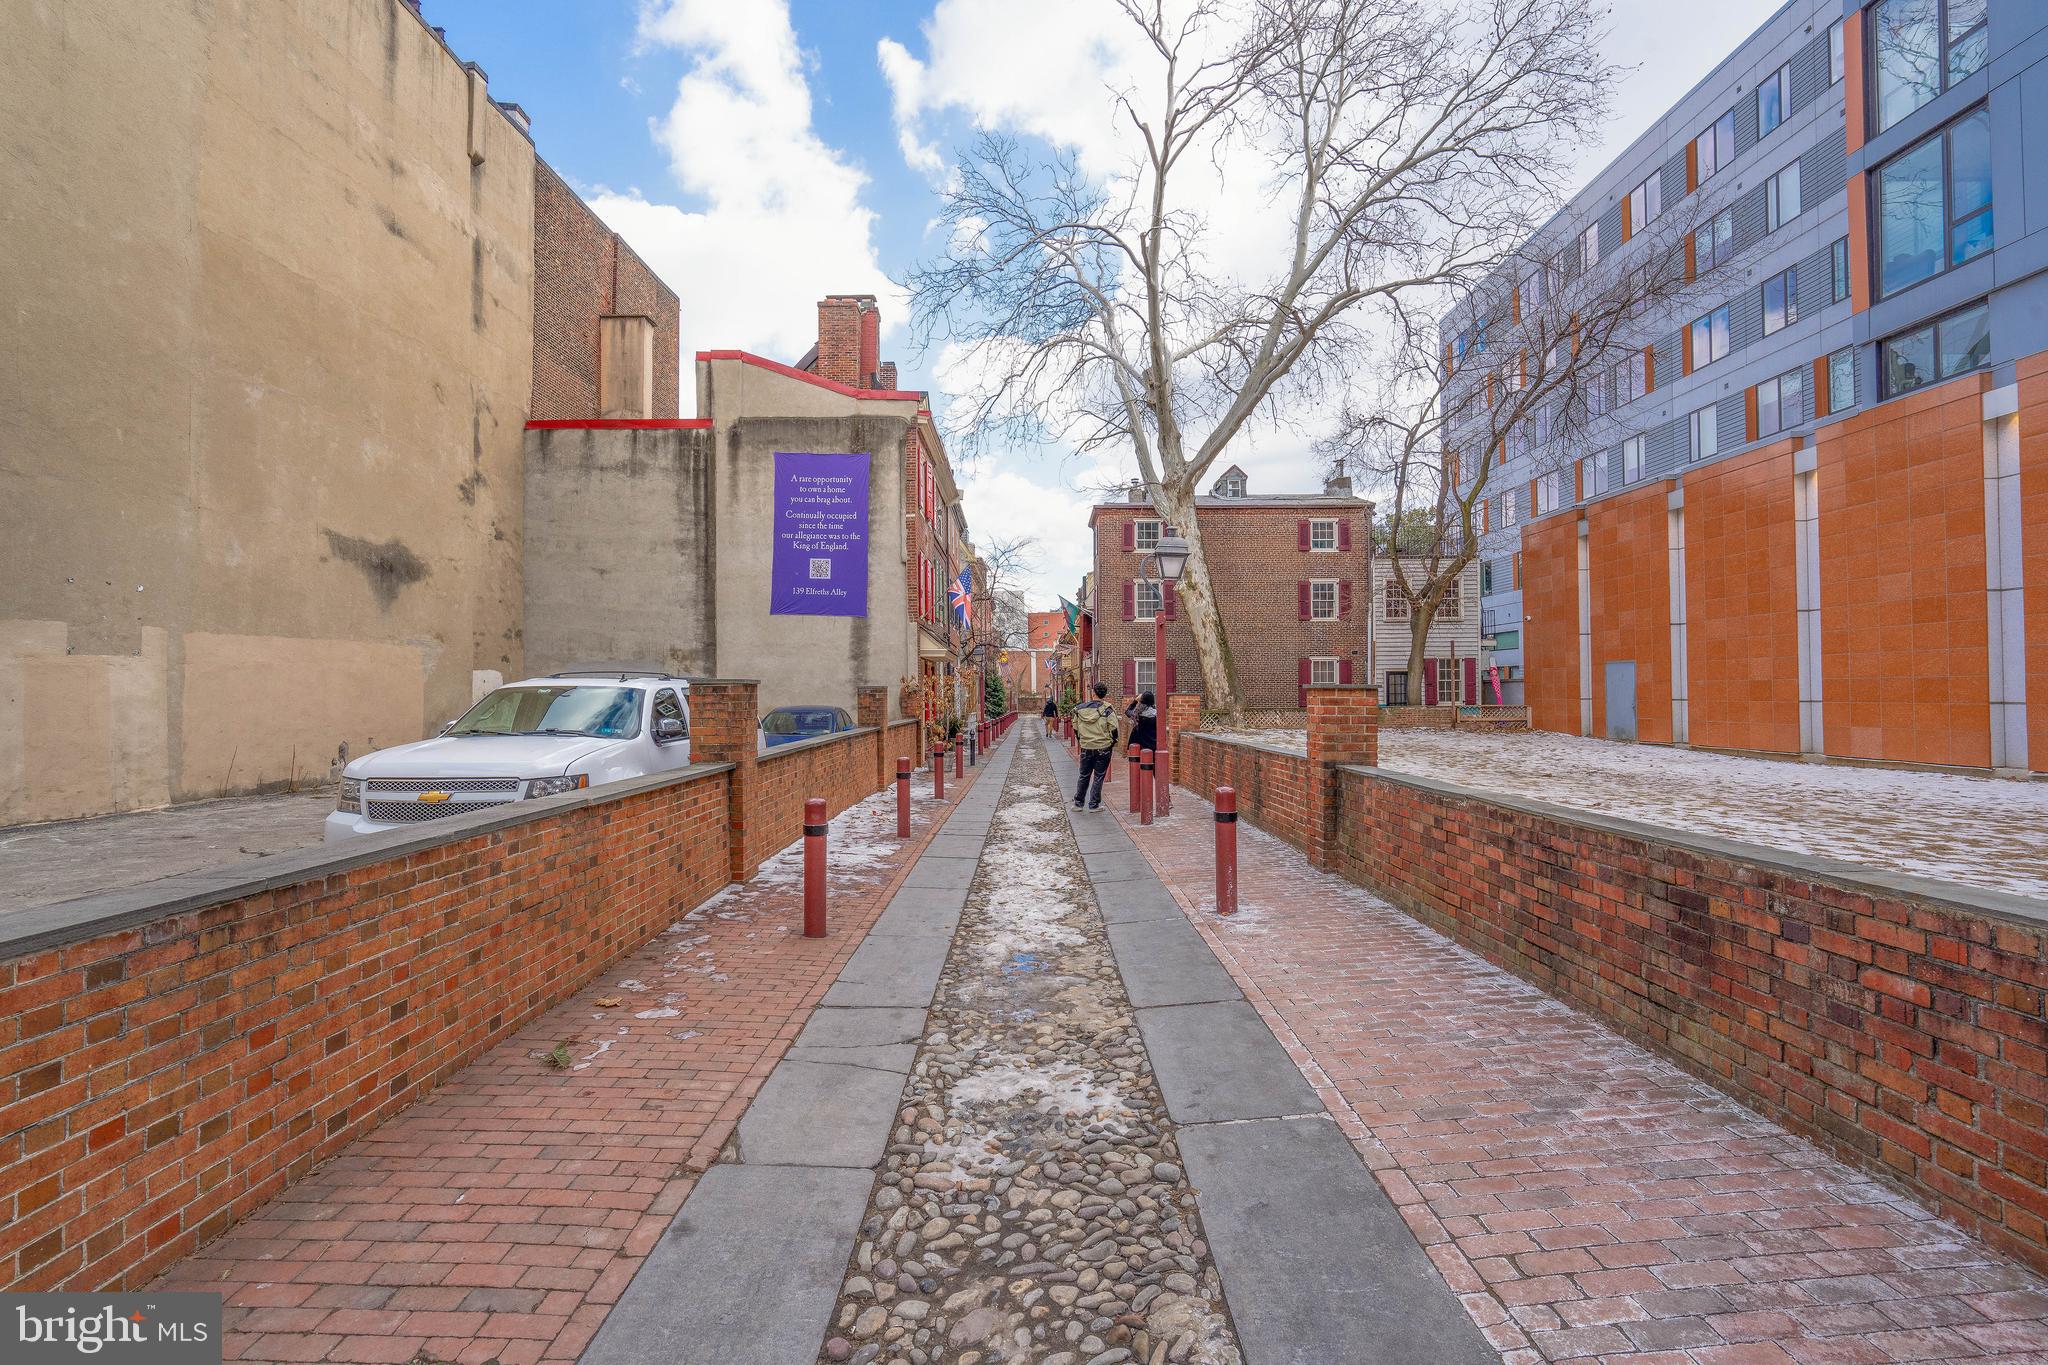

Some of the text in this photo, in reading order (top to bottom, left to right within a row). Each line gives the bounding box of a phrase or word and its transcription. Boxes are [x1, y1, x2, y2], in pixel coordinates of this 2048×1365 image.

[791, 474, 797, 482] A
[813, 475, 852, 485] opportunity
[827, 485, 845, 493] home
[790, 497, 802, 505] you
[816, 495, 830, 505] brag
[785, 510, 857, 522] Continually occupied
[795, 531, 827, 541] allegiance
[793, 541, 810, 551] King
[820, 542, 848, 552] England.
[792, 587, 804, 595] 139
[830, 588, 847, 597] Alley
